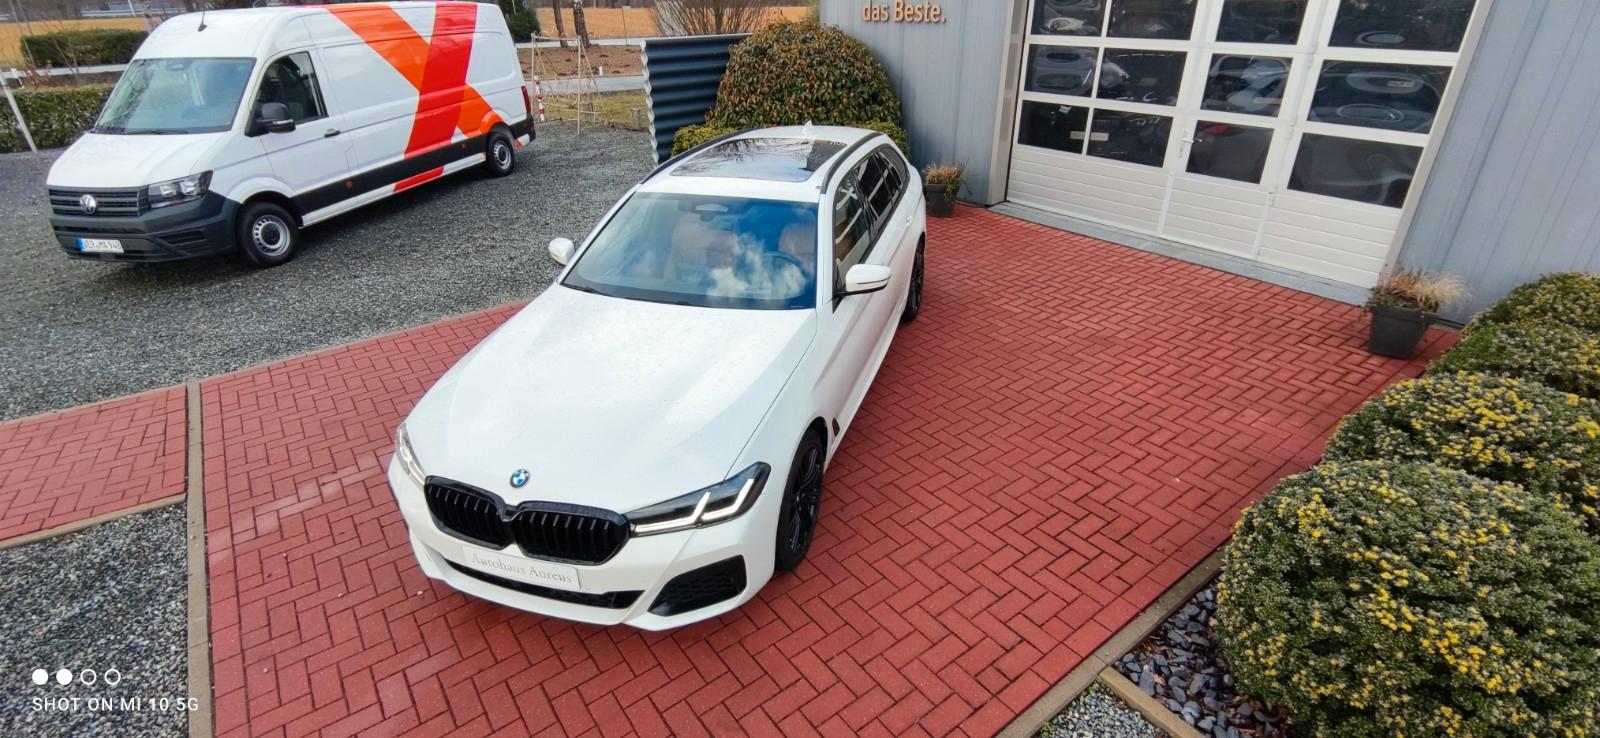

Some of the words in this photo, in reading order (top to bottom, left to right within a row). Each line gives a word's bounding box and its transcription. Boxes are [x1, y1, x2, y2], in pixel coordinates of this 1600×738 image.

[863, 0, 889, 22] das
[894, 0, 947, 23] Beste.
[472, 553, 526, 574] Autohaus
[529, 566, 572, 583] Aureus
